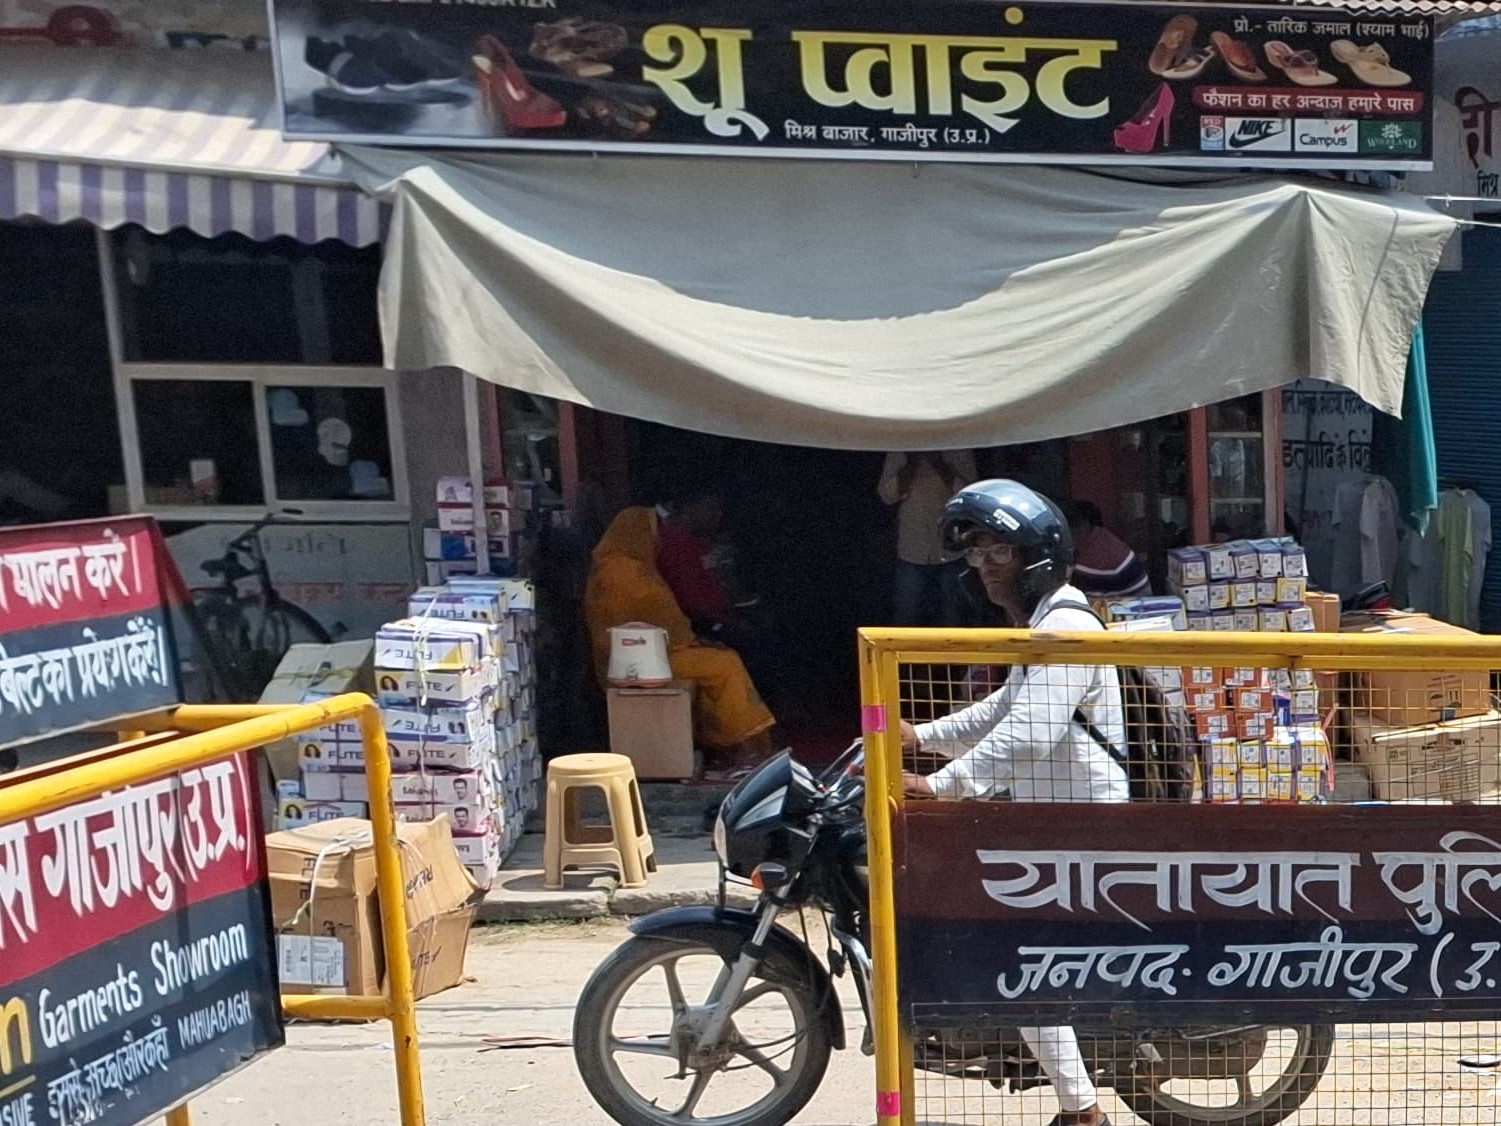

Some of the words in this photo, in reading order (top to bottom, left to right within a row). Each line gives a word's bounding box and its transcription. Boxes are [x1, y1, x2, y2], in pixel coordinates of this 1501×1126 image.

[1267, 17, 1307, 33] तारिक
[1313, 22, 1350, 36] जमाल
[1401, 21, 1429, 39] भाई)
[641, 23, 769, 141] शू
[791, 7, 1117, 133] प्वाइंट
[1237, 119, 1277, 136] NIKE
[1248, 95, 1266, 108] का
[1272, 96, 1290, 109] हर
[1348, 94, 1381, 113] हमारे
[1387, 98, 1414, 111] पास
[784, 119, 817, 140] मिश्र
[881, 122, 937, 147] गाजीपुर
[944, 126, 990, 145] (उ.प्र.)
[1300, 133, 1347, 148] Campus
[38, 648, 74, 704] का
[395, 648, 432, 660] FLTE
[34, 777, 186, 917] गाजीपुर
[976, 850, 1361, 932] यातायात
[38, 963, 143, 1048] Garments
[151, 922, 249, 997] Showroom
[1207, 925, 1418, 998] गाजीपुर
[177, 989, 253, 1049] MAHUABAGH
